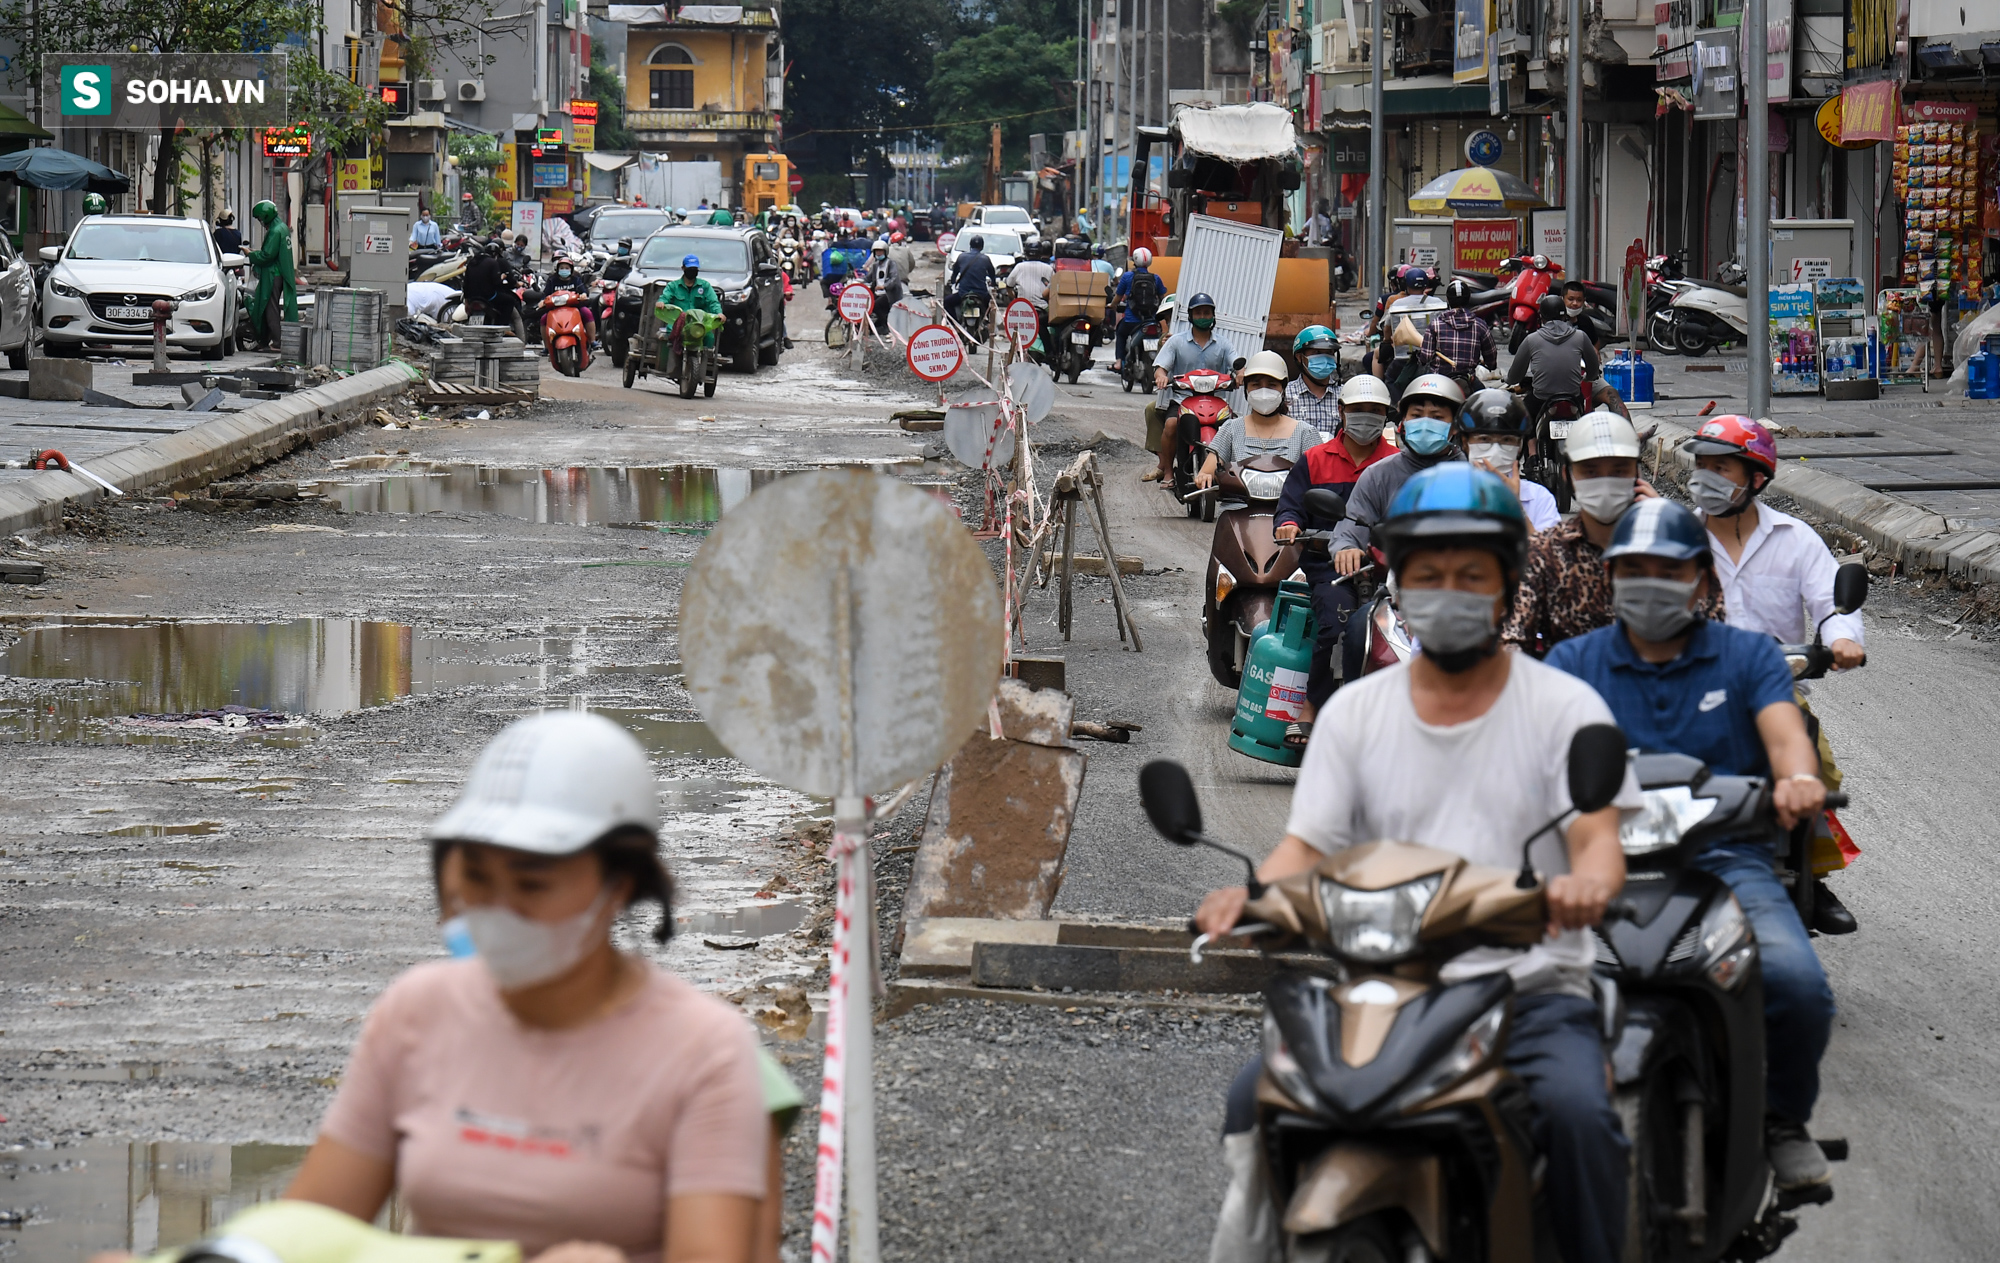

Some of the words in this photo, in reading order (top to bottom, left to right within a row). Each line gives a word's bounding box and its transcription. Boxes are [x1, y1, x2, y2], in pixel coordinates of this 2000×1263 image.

[1935, 107, 1967, 115] ORION
[1470, 132, 1499, 149] KidsPlaza
[1336, 145, 1365, 162] aha
[1458, 229, 1468, 245] ĐỆ
[1469, 226, 1490, 242] NHẤT
[1490, 228, 1512, 242] QUÁN
[1461, 248, 1485, 264] THỊT
[1486, 245, 1510, 260] CHÓ
[1770, 303, 1790, 312] SIM
[913, 340, 930, 350] CÔNG
[930, 336, 954, 348] TRƯỜNG
[913, 353, 930, 363] ĐANG
[931, 352, 941, 360] THI
[941, 349, 958, 359] CÔNG
[928, 364, 948, 373] 5KM/h
[1250, 664, 1274, 685] GAS
[1249, 702, 1263, 714] GAS
